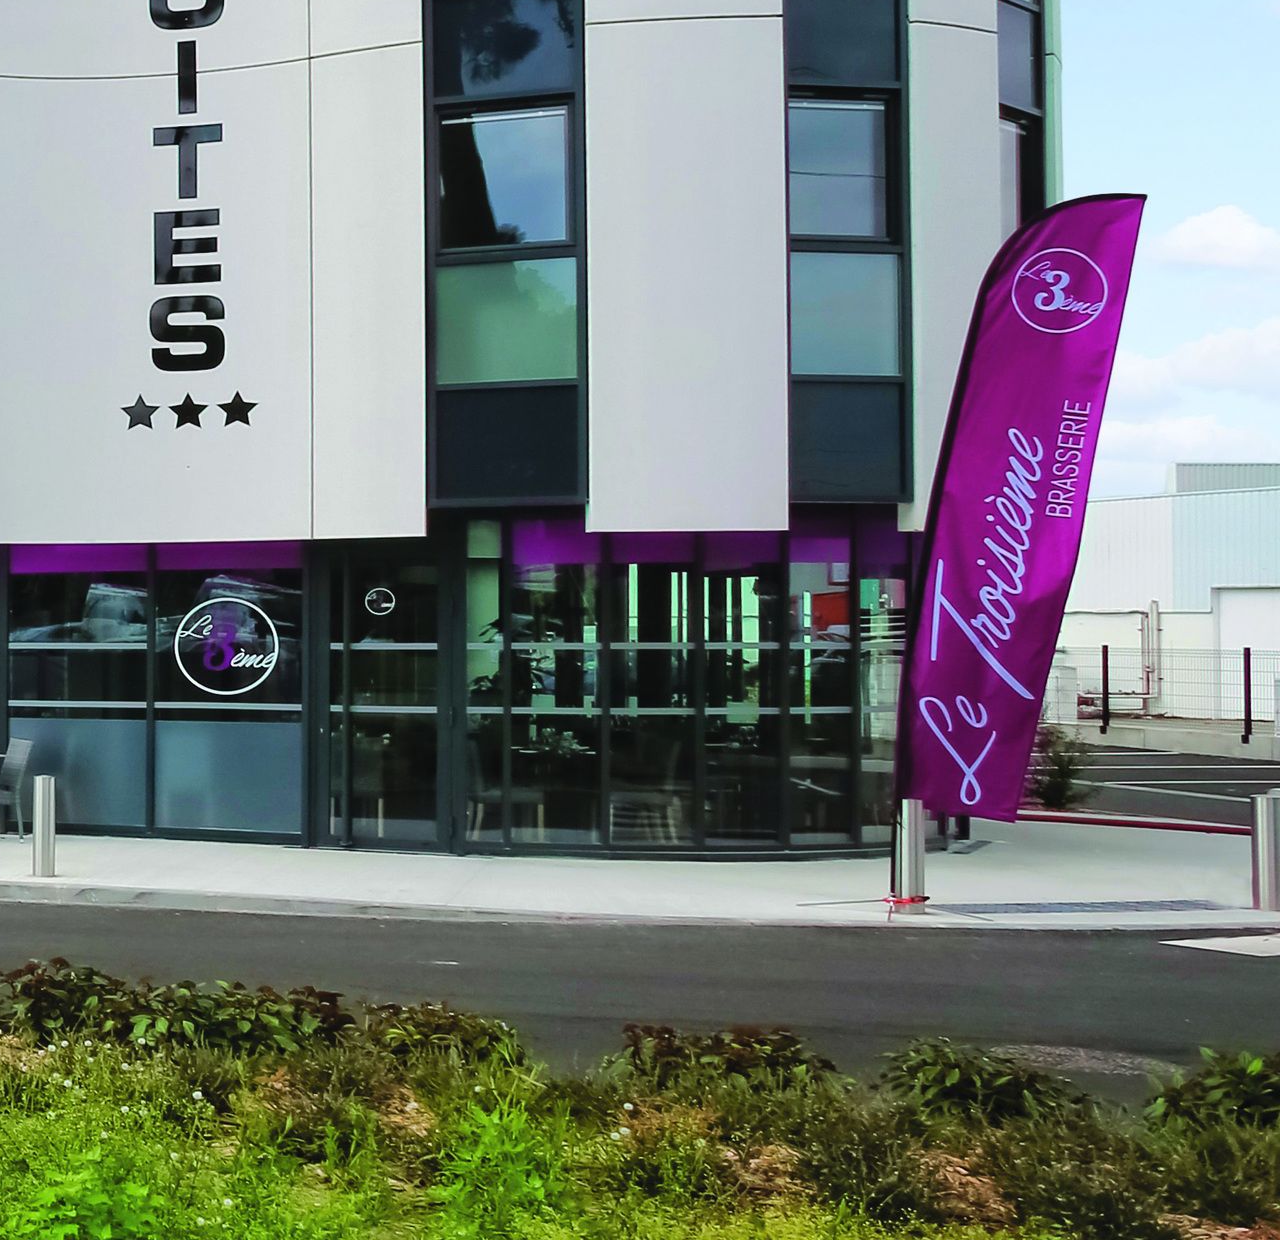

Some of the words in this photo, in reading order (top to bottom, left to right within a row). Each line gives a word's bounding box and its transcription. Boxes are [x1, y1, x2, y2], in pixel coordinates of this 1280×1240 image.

[1045, 399, 1092, 519] BRASSERIE
[930, 426, 1045, 701] Troisième
[180, 614, 213, 638] Le
[203, 622, 277, 671] 3ème
[919, 695, 996, 806] Le
